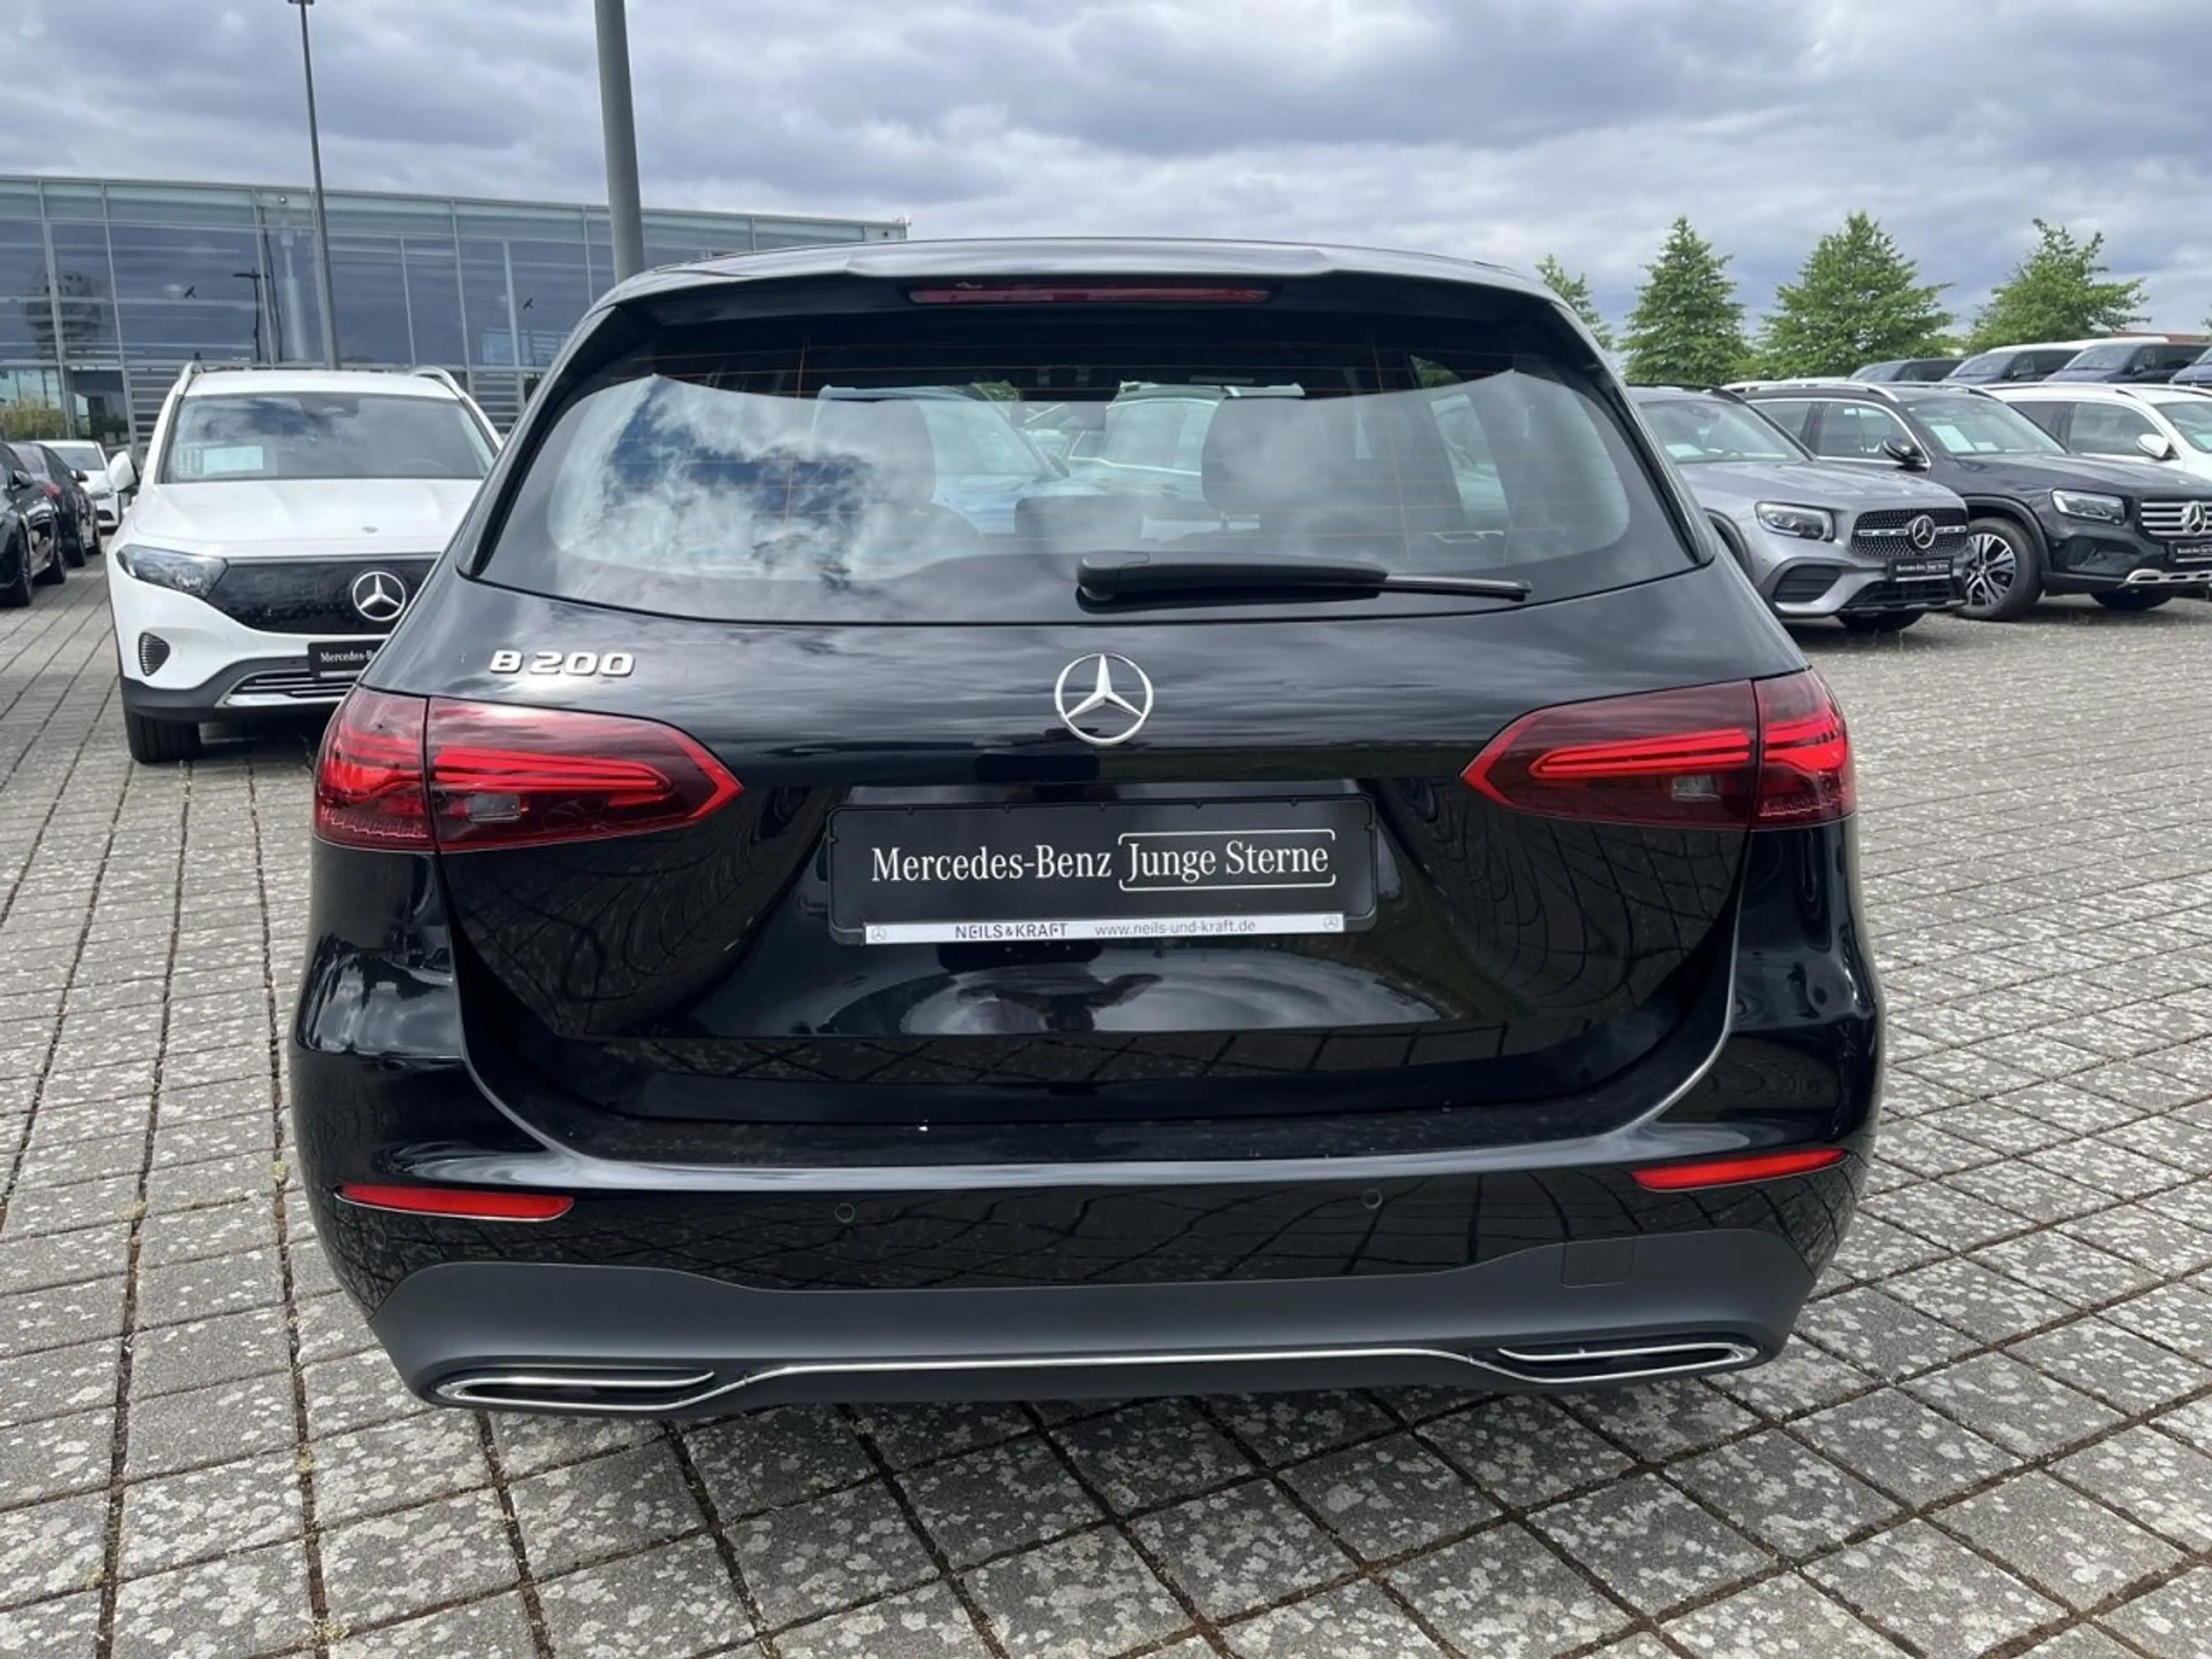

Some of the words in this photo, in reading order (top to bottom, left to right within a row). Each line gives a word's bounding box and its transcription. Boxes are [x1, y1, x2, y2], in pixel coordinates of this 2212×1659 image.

[490, 650, 523, 673] B
[529, 651, 635, 677] 200
[871, 844, 1112, 882] Mercedes-Benz
[1126, 843, 1217, 884] Junge
[1225, 839, 1329, 875] Sterne
[1095, 919, 1256, 936] www.neils-und-kraft.de
